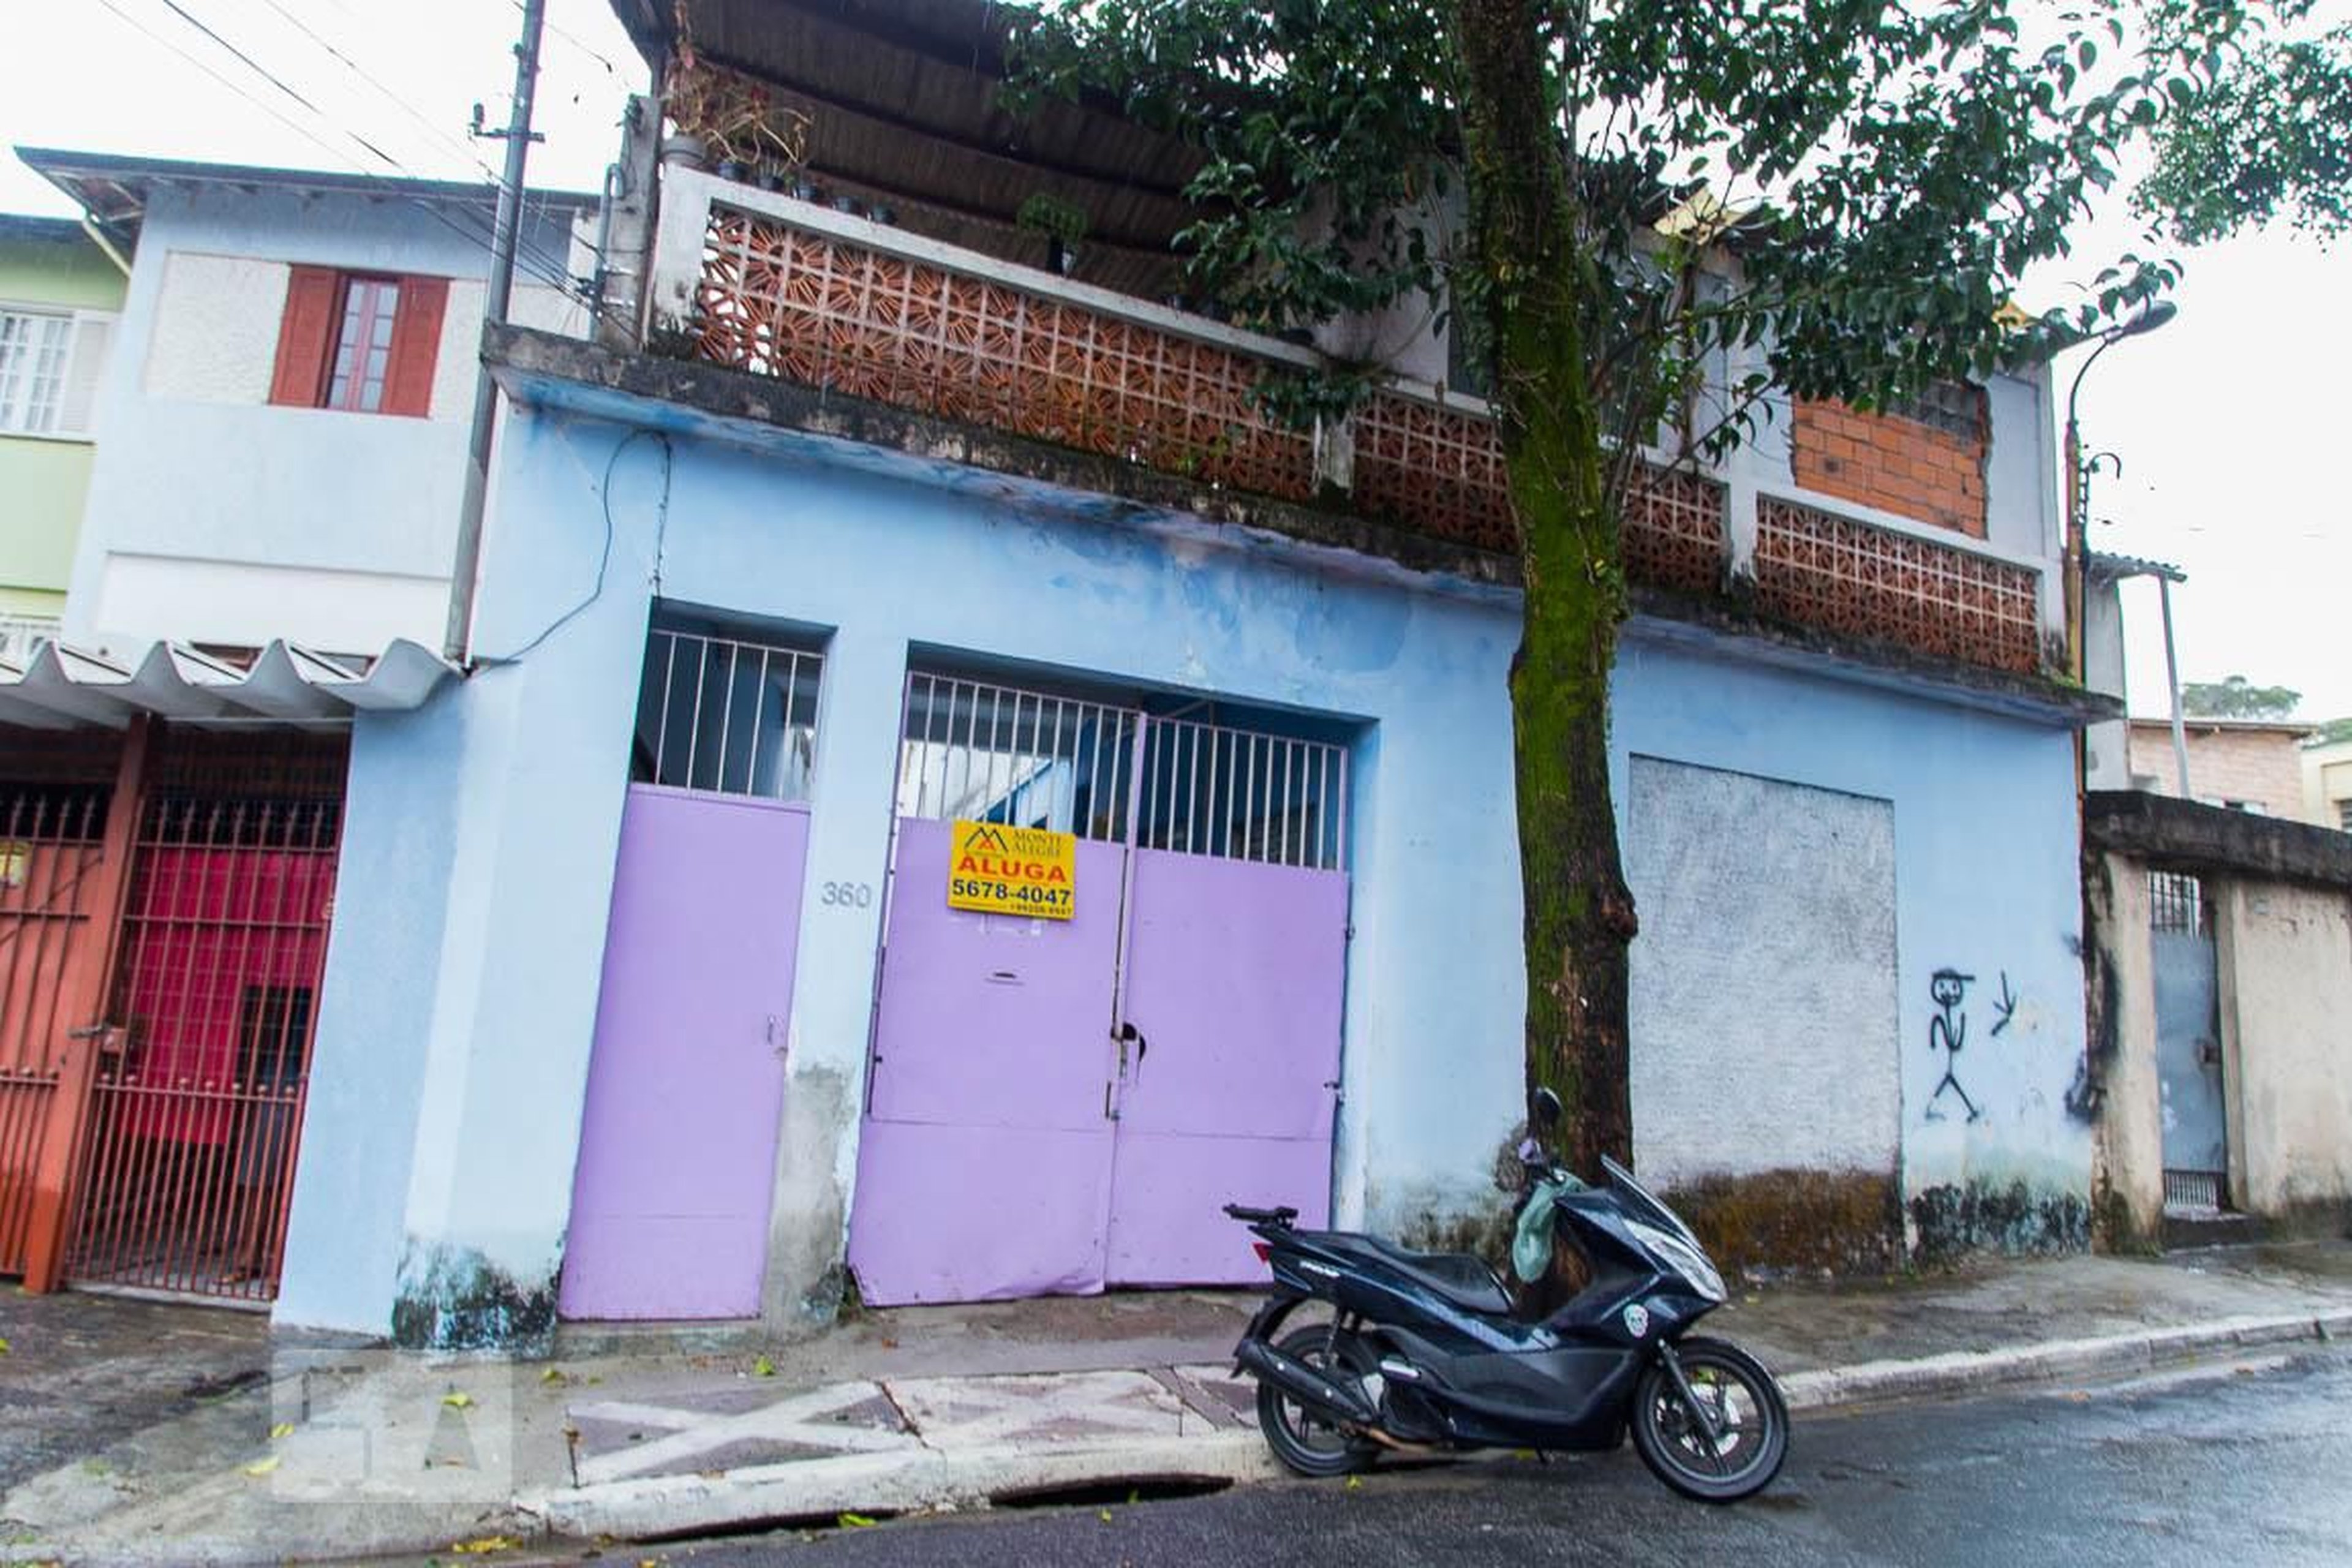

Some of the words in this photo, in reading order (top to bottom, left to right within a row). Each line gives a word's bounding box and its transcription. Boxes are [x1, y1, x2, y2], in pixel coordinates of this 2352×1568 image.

[957, 856, 1066, 883] ALUGA
[821, 881, 872, 908] 360
[952, 878, 1071, 905] 5678-4047
